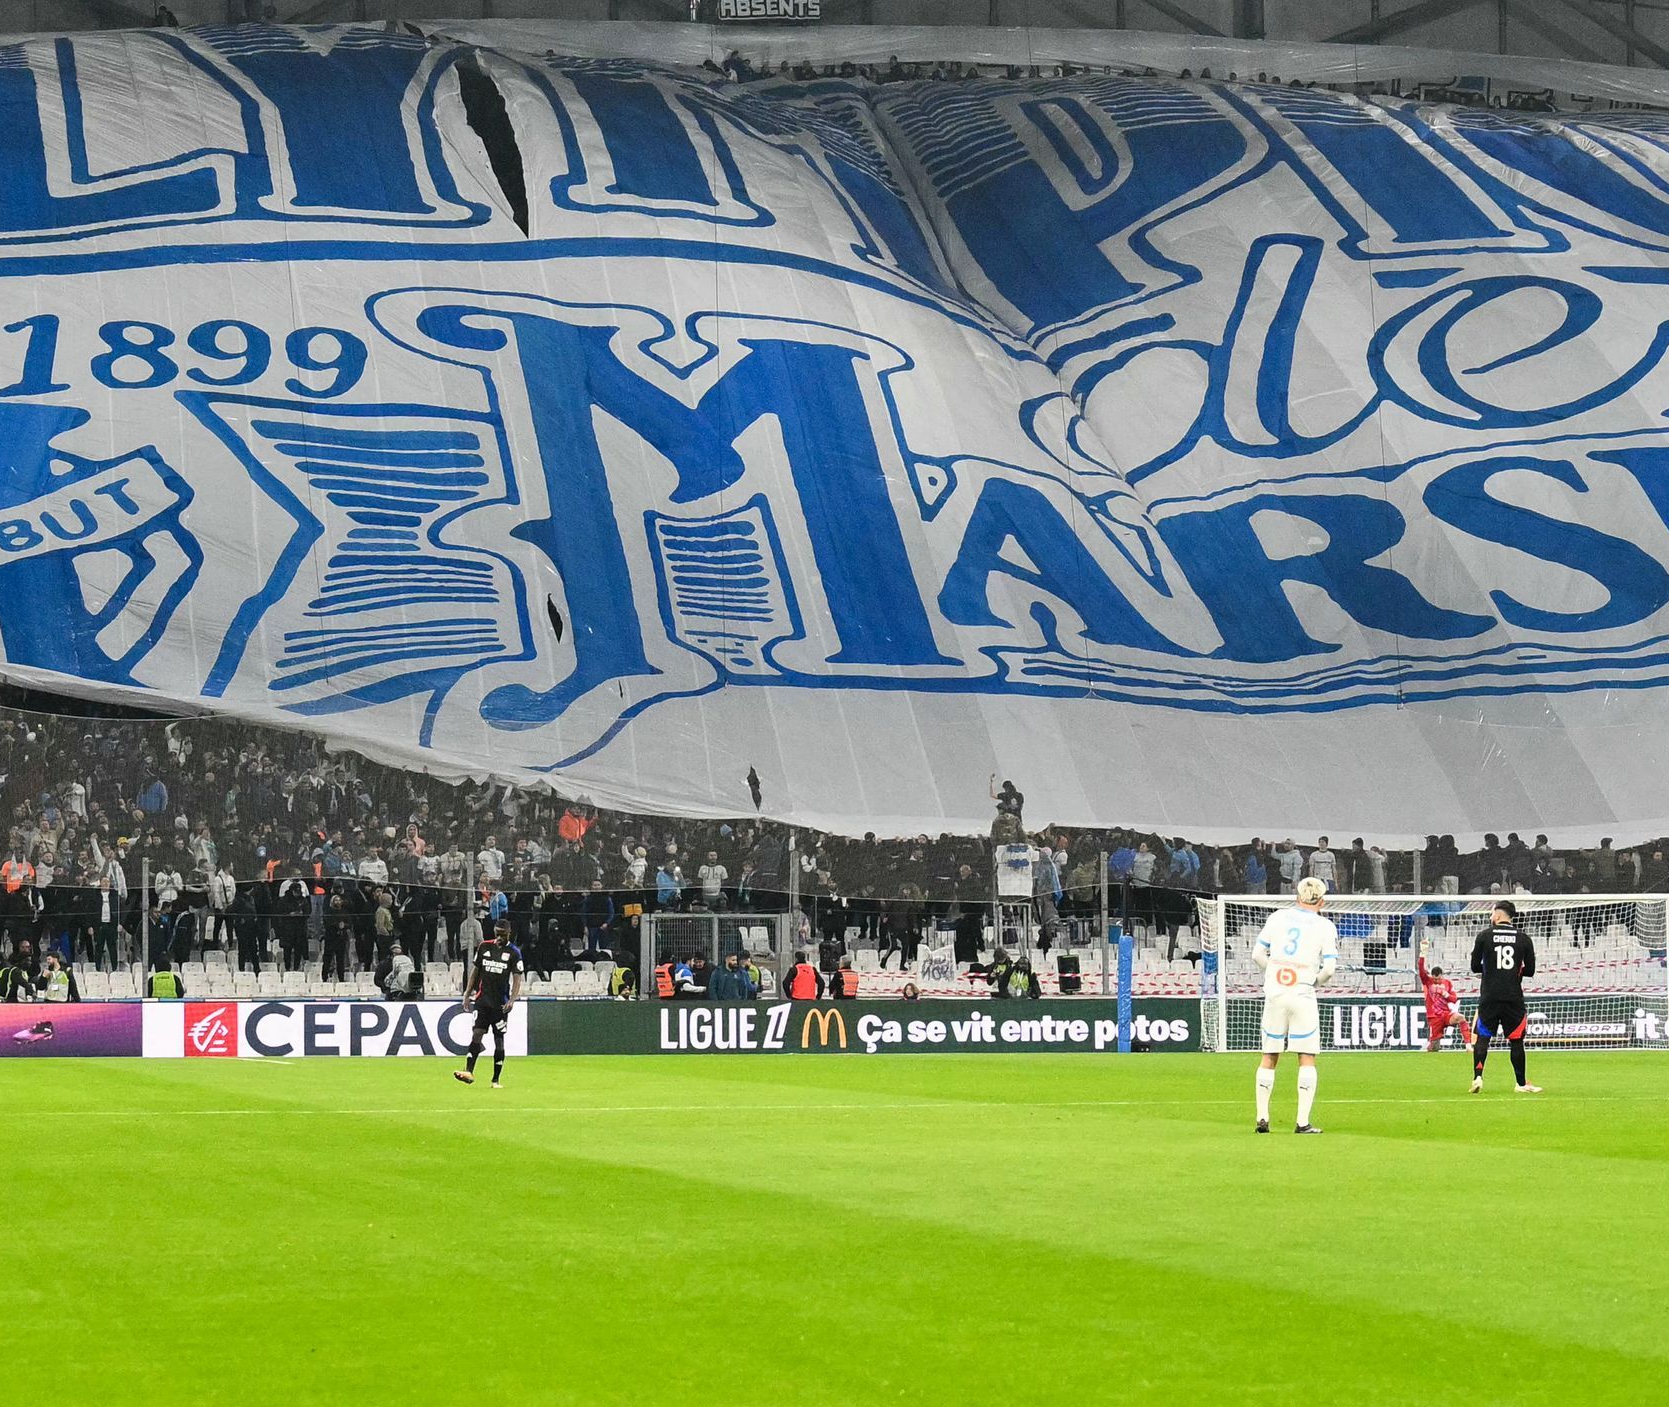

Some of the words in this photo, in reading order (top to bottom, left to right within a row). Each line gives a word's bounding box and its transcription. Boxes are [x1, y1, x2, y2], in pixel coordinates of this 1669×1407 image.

[1283, 927, 1301, 956] 3
[1494, 945, 1515, 970] 18
[244, 1003, 486, 1056] CEPAC
[660, 1008, 757, 1050] LIGUE
[857, 1013, 903, 1053] Ça
[907, 1020, 946, 1043] se
[949, 1011, 995, 1043] vit
[1000, 1013, 1089, 1043] entre
[1333, 1005, 1427, 1048] LIGUE
[1566, 1024, 1624, 1034] SPORT
